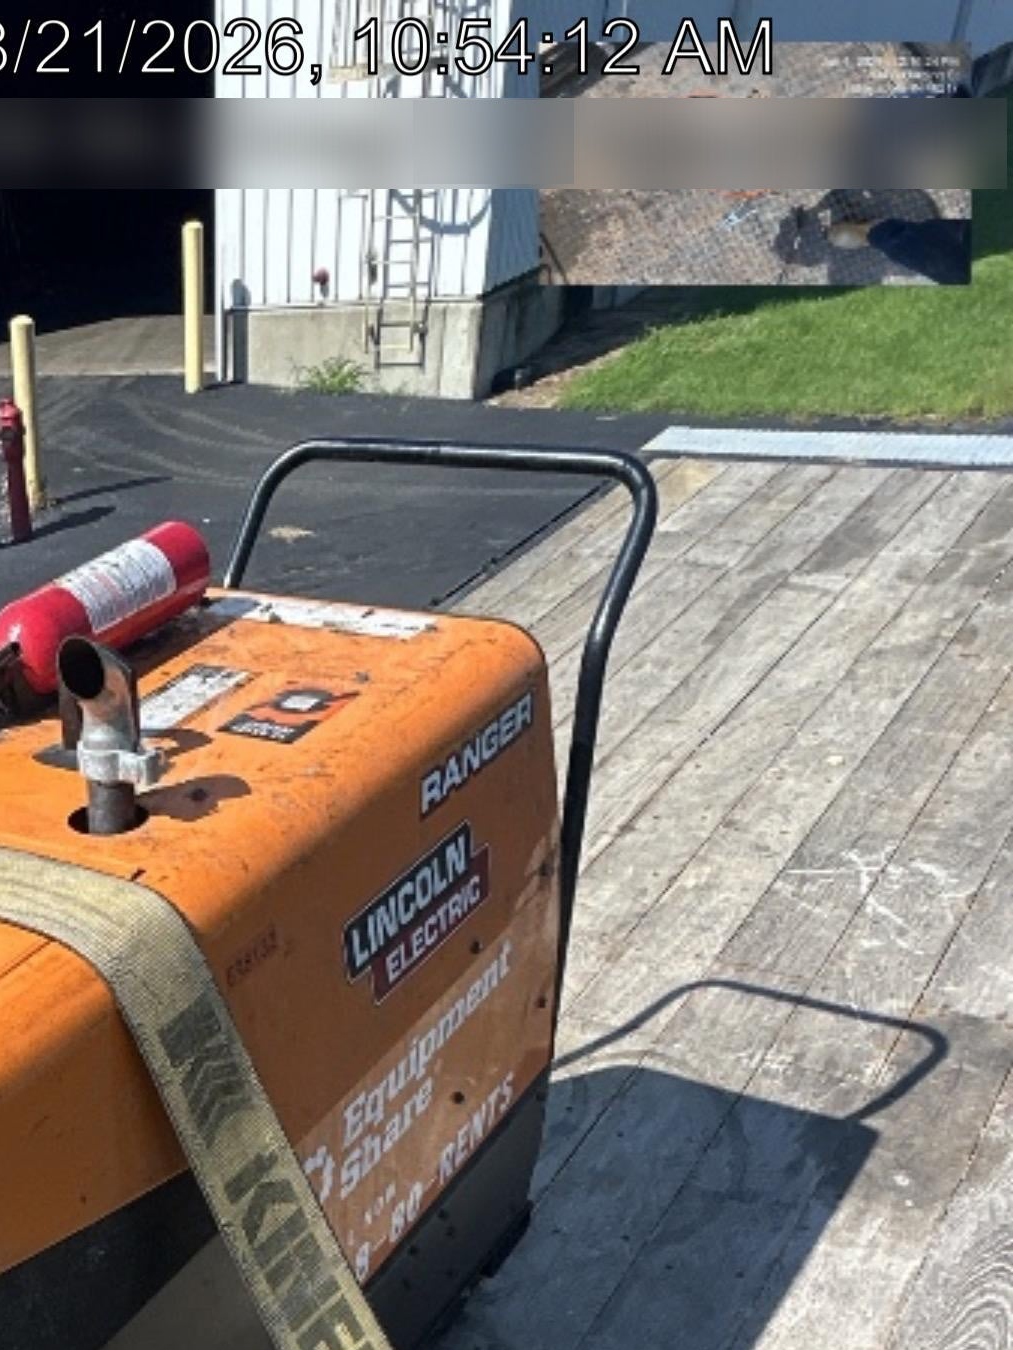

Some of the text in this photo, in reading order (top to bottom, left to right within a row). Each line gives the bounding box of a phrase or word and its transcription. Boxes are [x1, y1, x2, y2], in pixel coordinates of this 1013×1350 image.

[420, 692, 533, 814] RANGER
[352, 833, 467, 968] LINCOLN
[385, 875, 481, 984] ELECTRIC
[343, 938, 512, 1147] Equipment
[340, 1076, 434, 1200] Share
